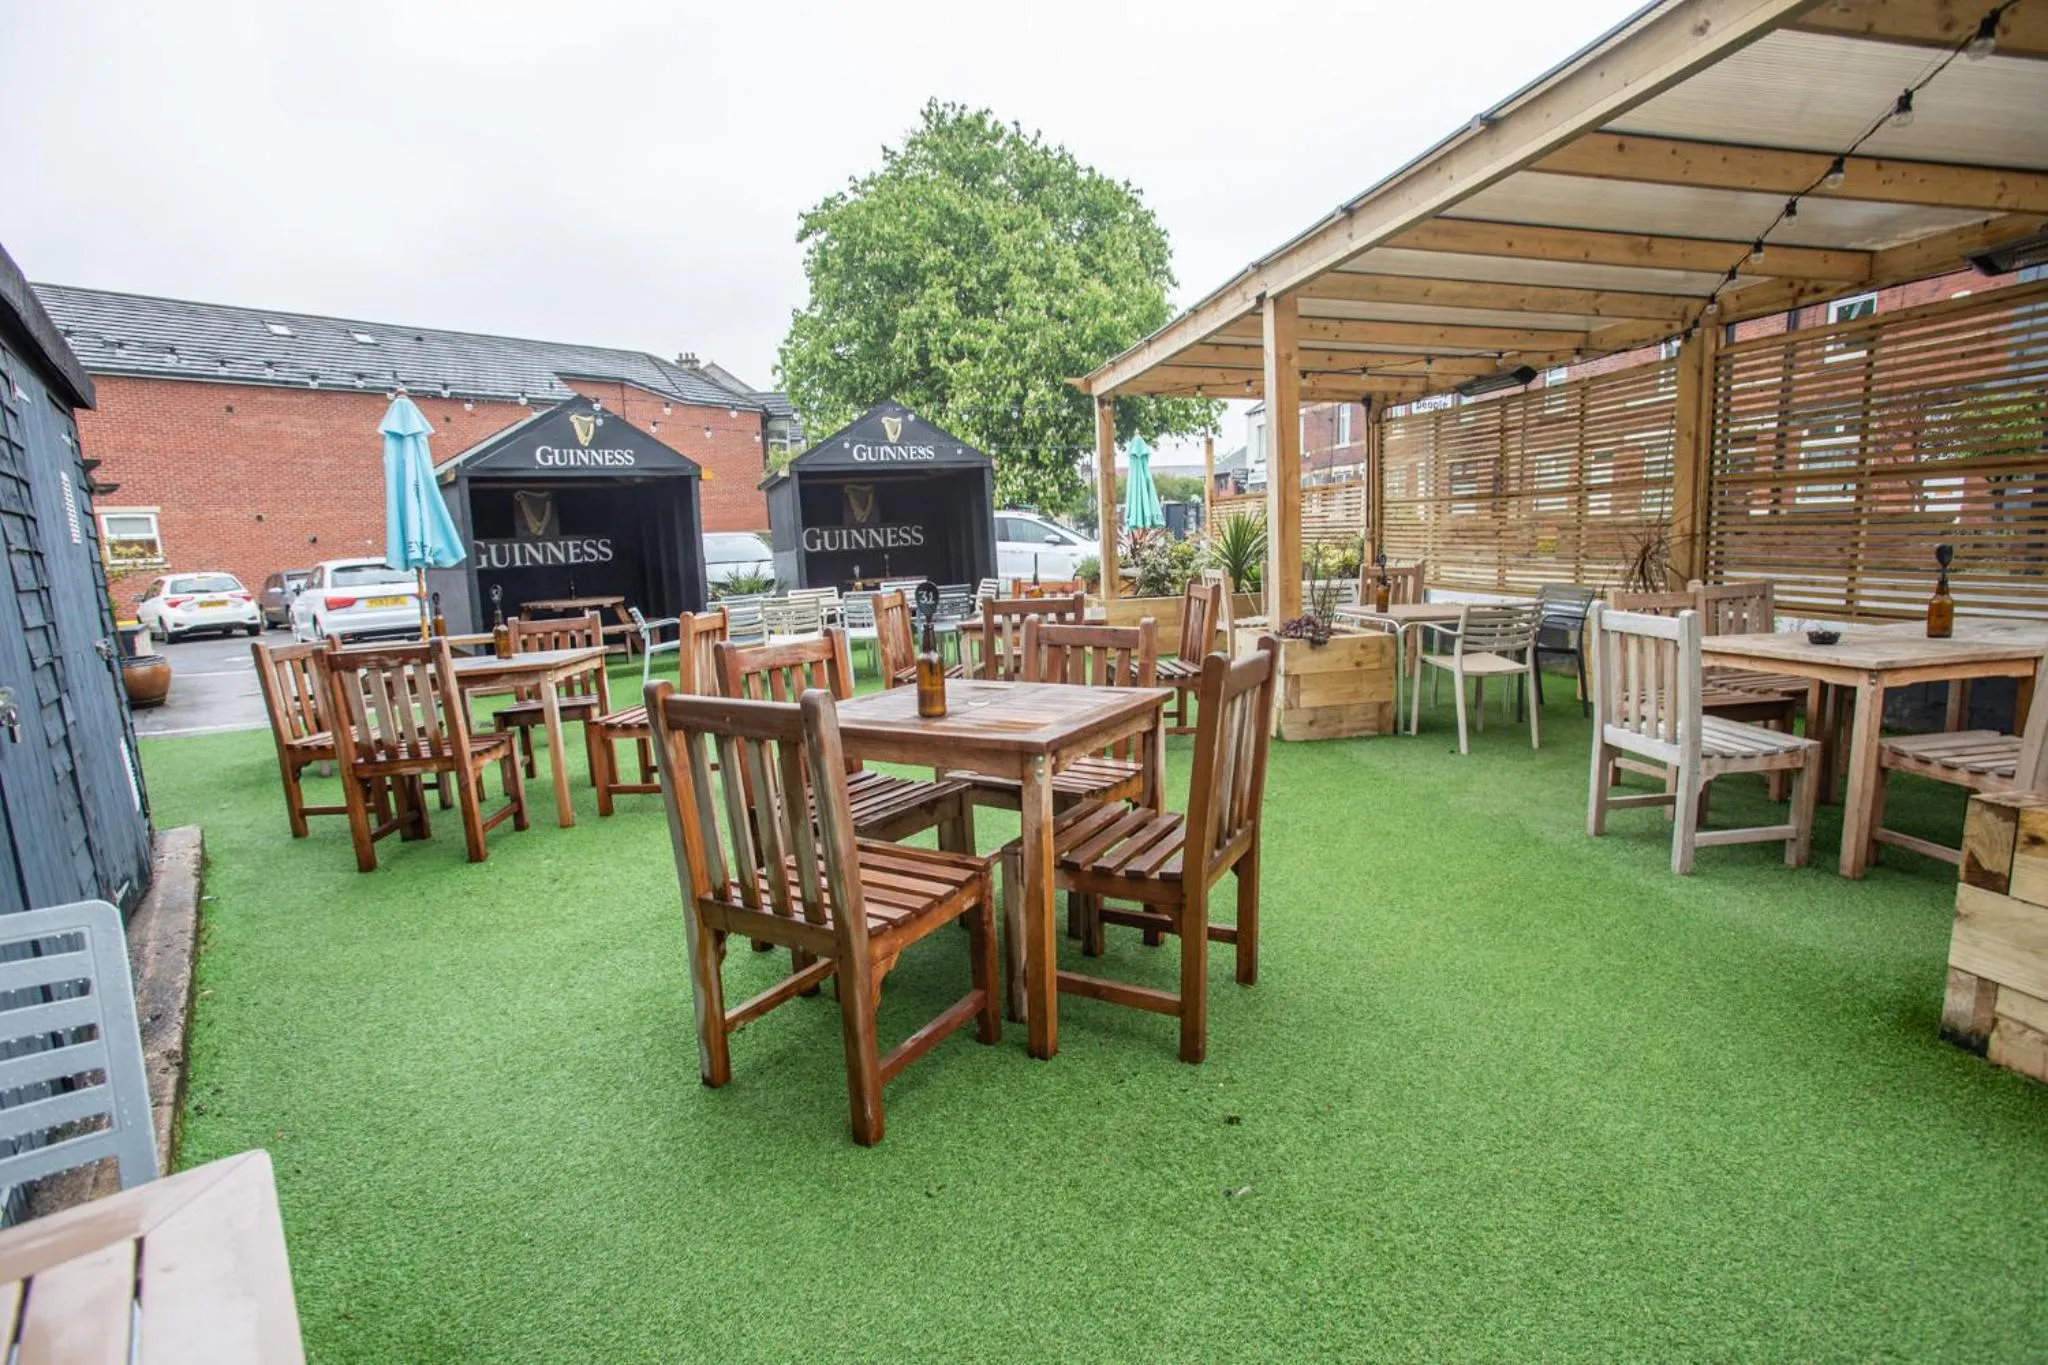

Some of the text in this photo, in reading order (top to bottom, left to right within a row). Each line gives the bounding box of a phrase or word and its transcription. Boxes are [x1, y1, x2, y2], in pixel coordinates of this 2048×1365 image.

[535, 445, 635, 466] GUINNESS
[852, 443, 935, 463] GUINNESS
[803, 525, 925, 553] GUINNESS
[918, 590, 935, 604] 31
